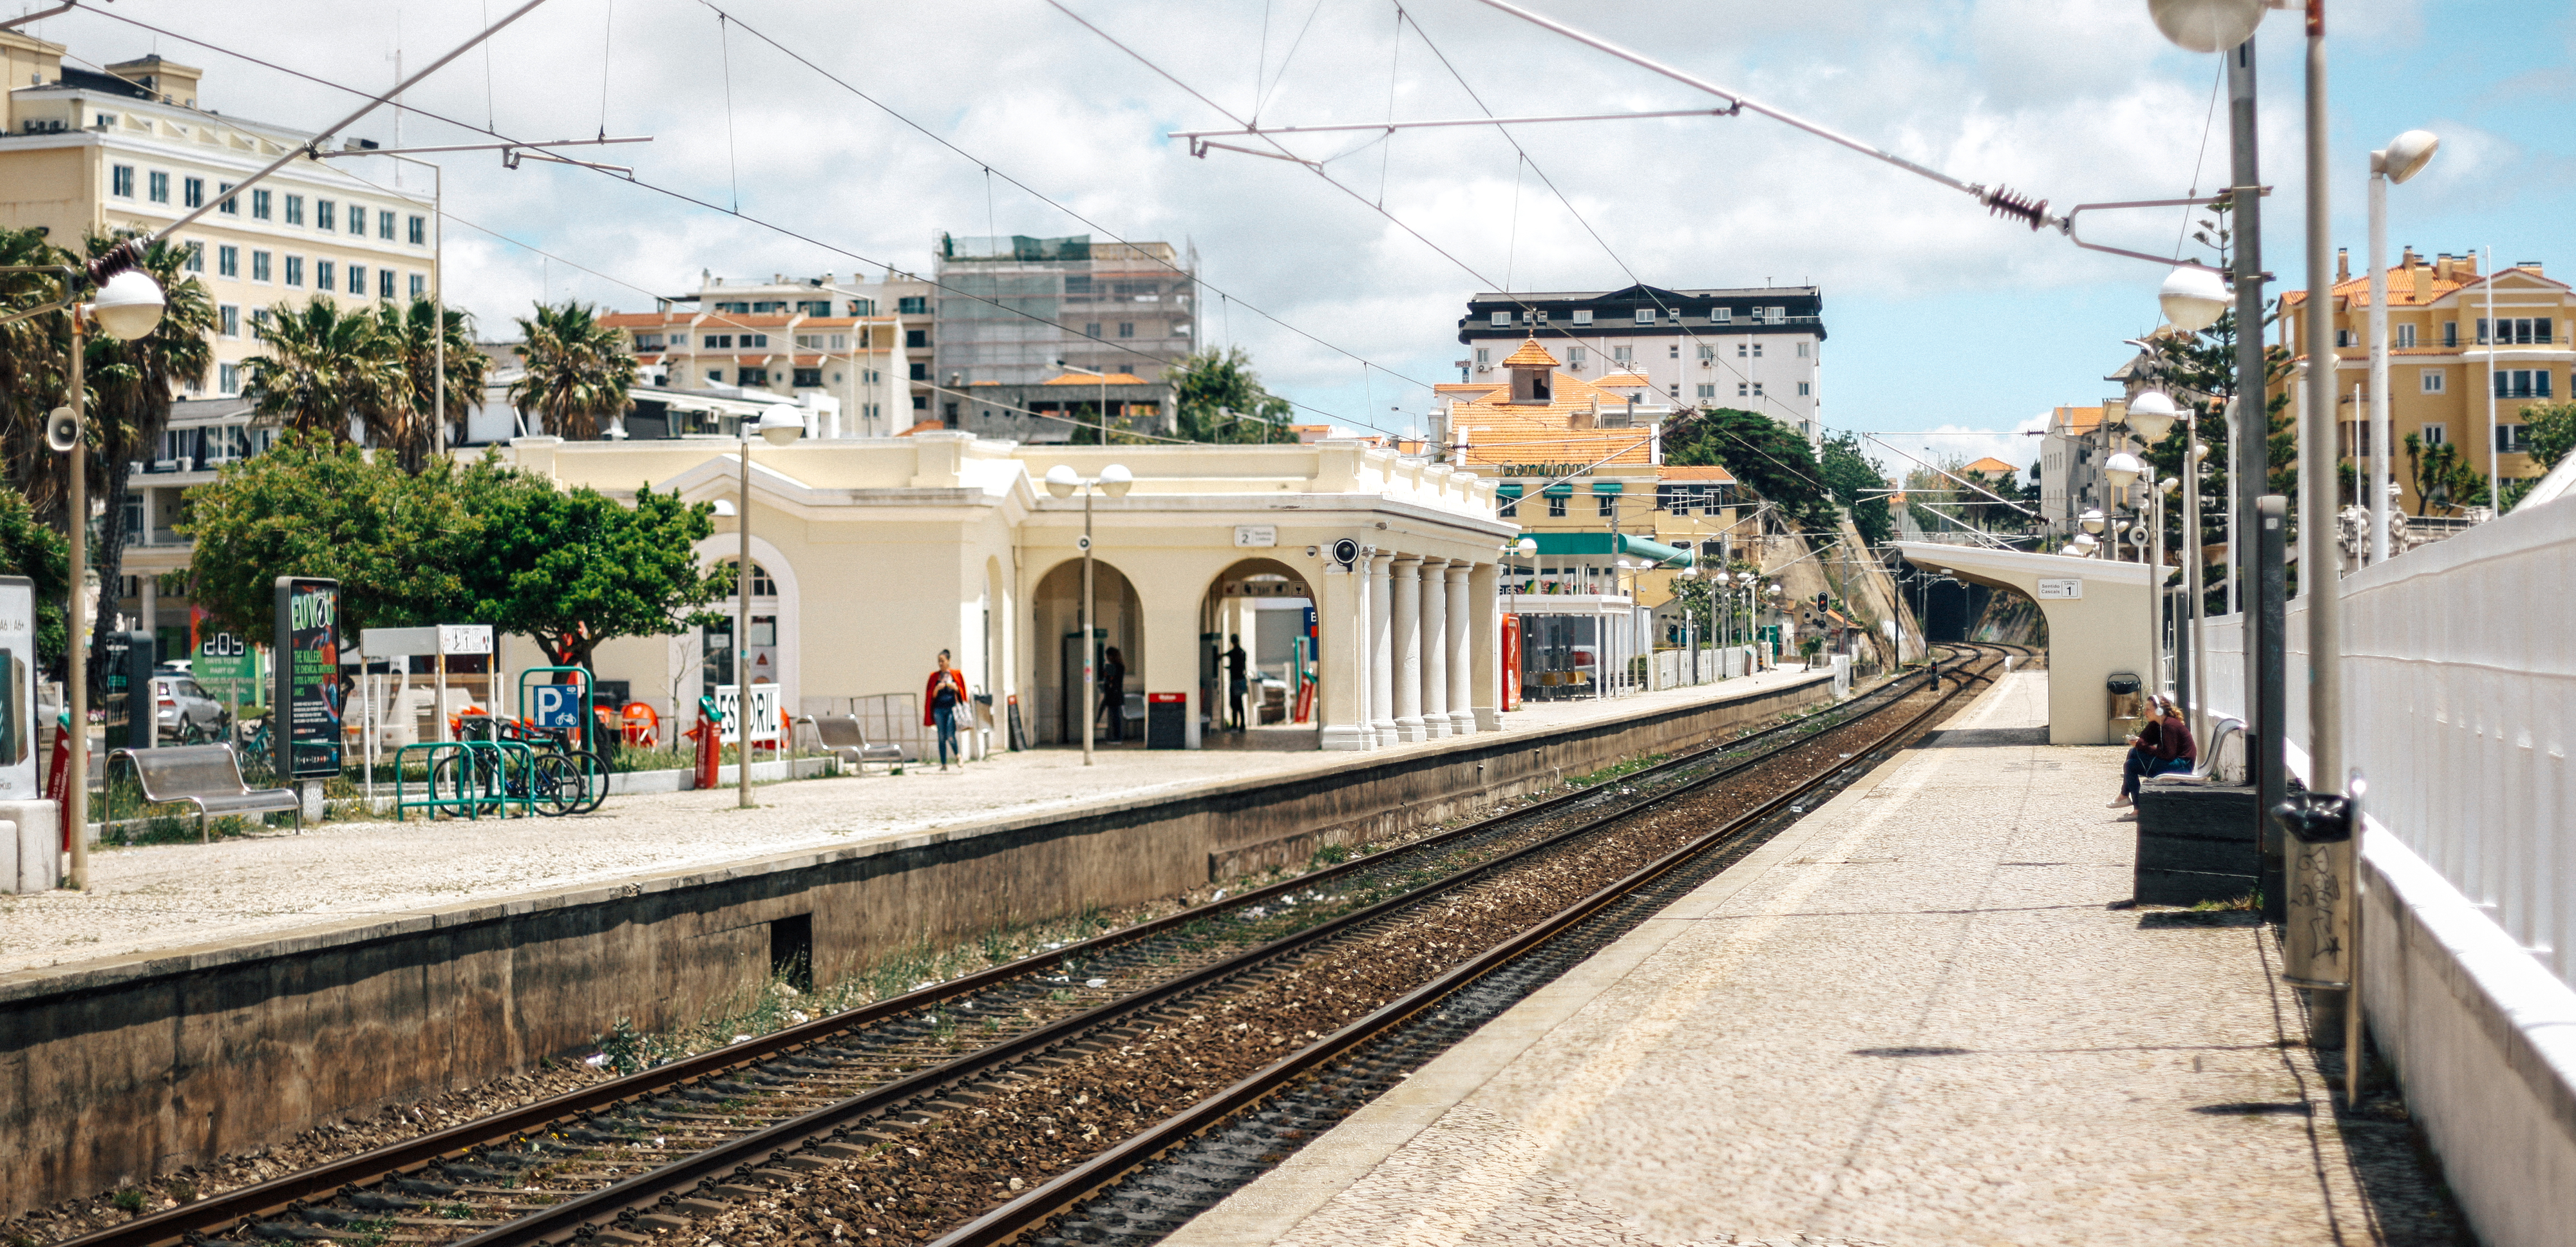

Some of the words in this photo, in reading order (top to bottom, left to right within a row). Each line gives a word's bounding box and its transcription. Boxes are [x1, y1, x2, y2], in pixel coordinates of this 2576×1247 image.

[1501, 459, 1594, 477] Gordinni
[1242, 534, 1249, 543] 2
[1613, 529, 1616, 543] 28
[2067, 586, 2071, 596] 1
[14, 619, 24, 631] A6+
[303, 651, 323, 663] KILLERS
[538, 687, 562, 726] P
[721, 692, 777, 734] ESORIL
